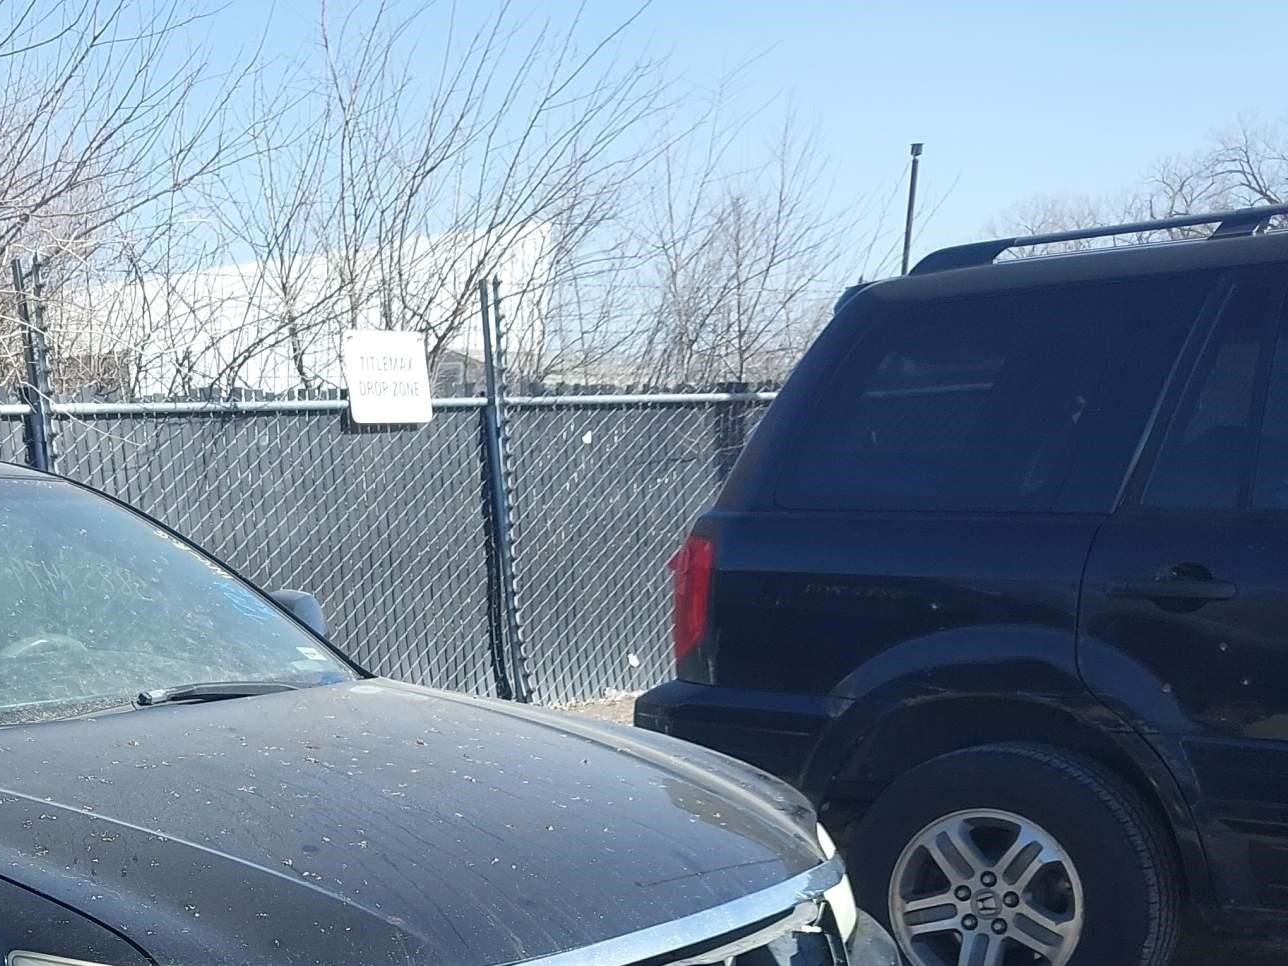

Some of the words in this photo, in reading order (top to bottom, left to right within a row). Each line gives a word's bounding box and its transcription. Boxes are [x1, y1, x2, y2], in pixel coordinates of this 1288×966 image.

[360, 356, 414, 371] TITLEMAX
[359, 381, 389, 396] DROP
[393, 381, 420, 397] ZONE
